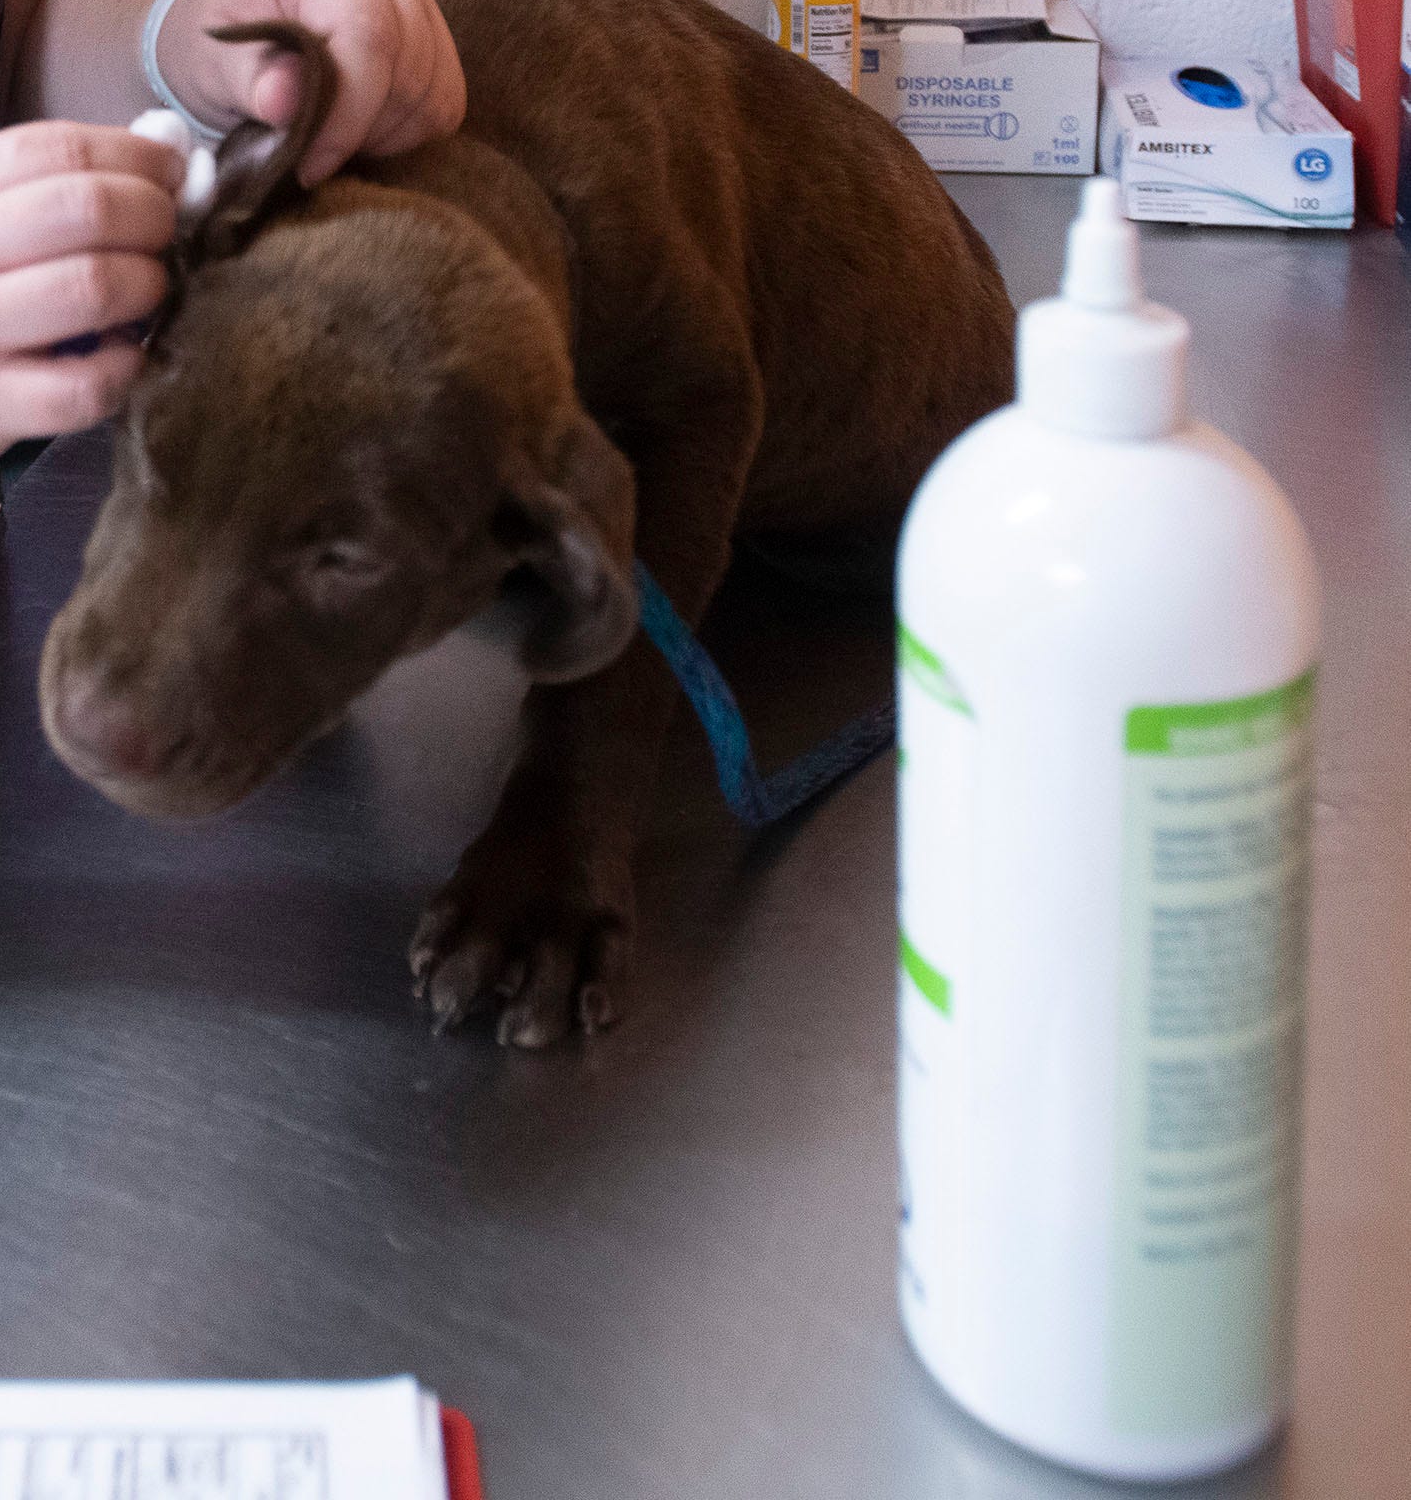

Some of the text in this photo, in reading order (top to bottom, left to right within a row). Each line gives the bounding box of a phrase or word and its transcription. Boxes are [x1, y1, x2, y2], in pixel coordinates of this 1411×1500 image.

[896, 77, 1013, 91] DISPOSABLE
[909, 94, 1001, 108] SYRINGES
[900, 120, 980, 130] without needle
[1138, 142, 1213, 155] AMBITEX
[1300, 157, 1326, 173] LG
[1293, 197, 1320, 210] 100
